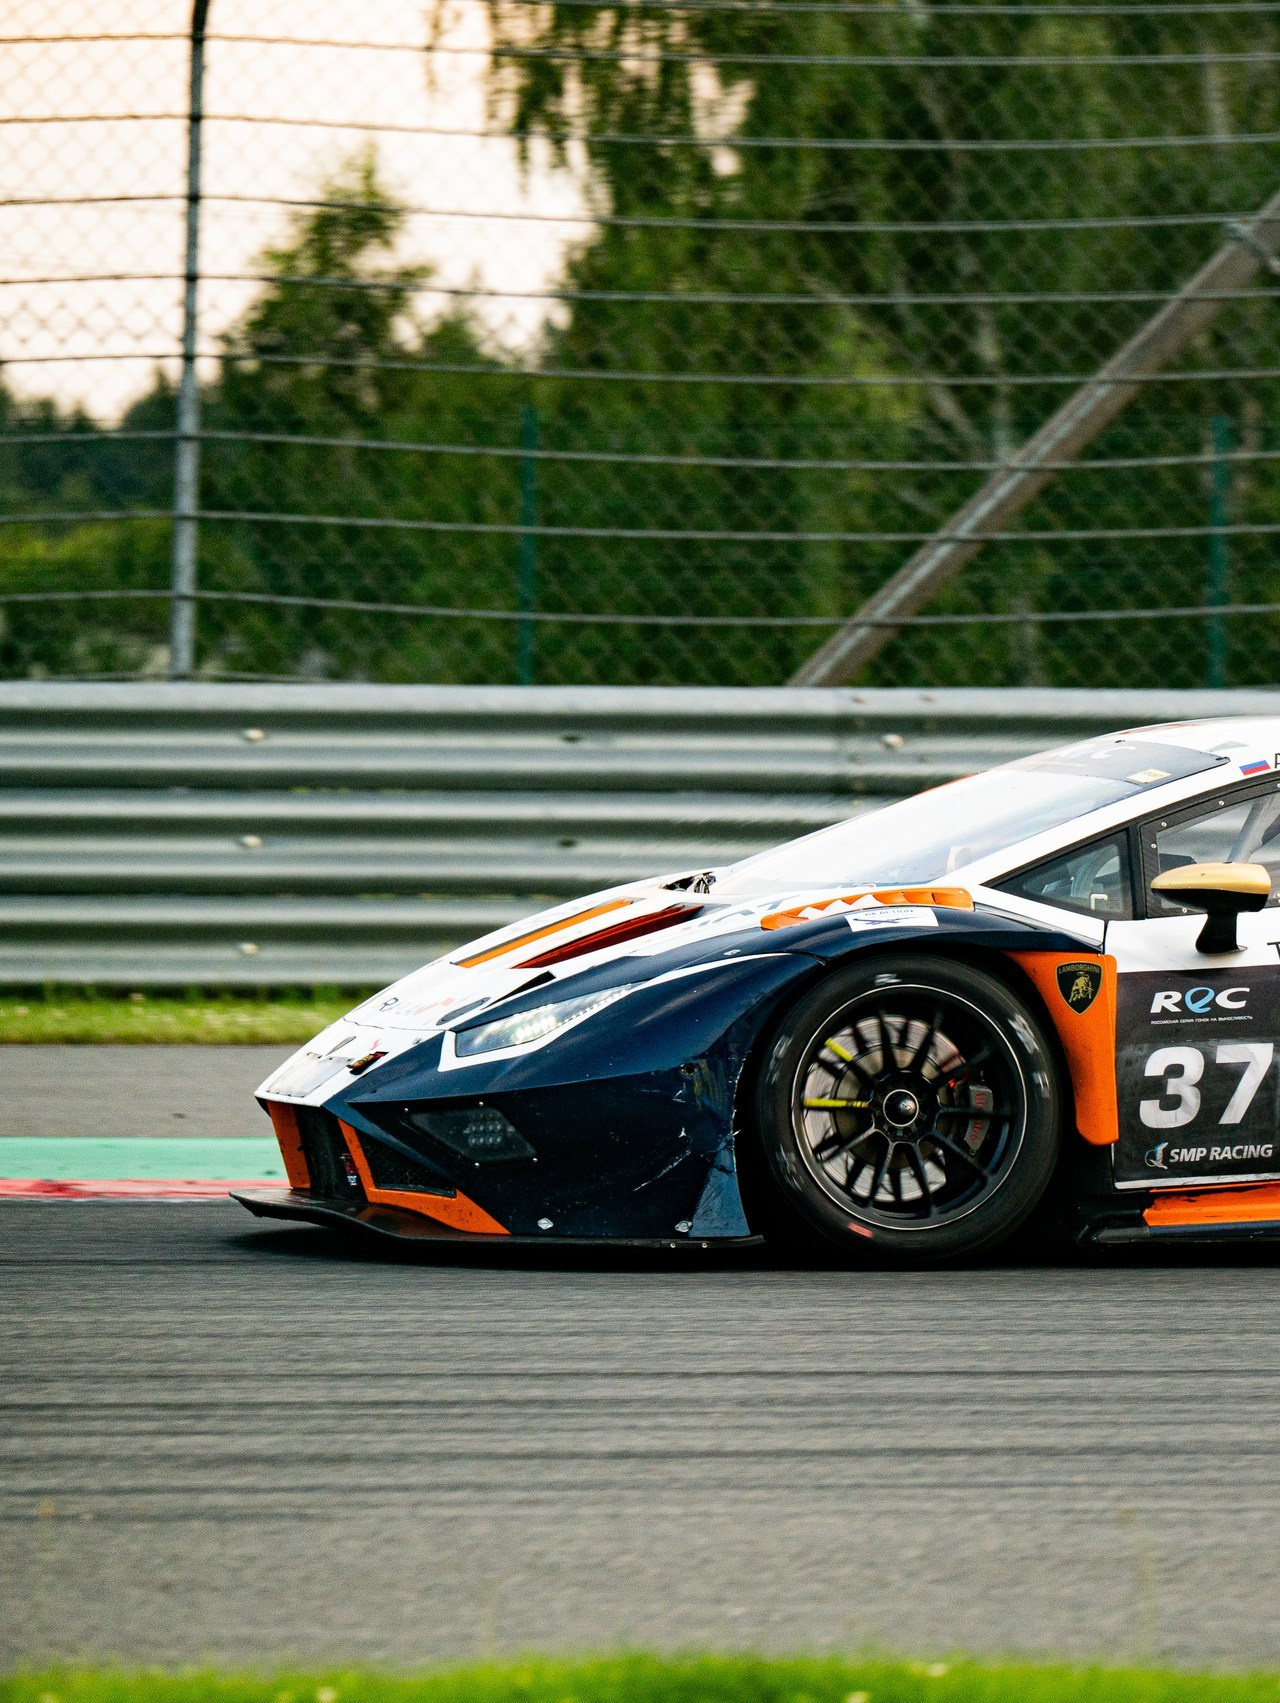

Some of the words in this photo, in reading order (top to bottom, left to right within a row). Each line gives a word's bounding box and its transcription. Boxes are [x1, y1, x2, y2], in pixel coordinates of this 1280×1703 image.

[1139, 1043, 1274, 1128] 37
[1169, 1147, 1207, 1162] SMP
[1209, 1144, 1273, 1160] RACING
